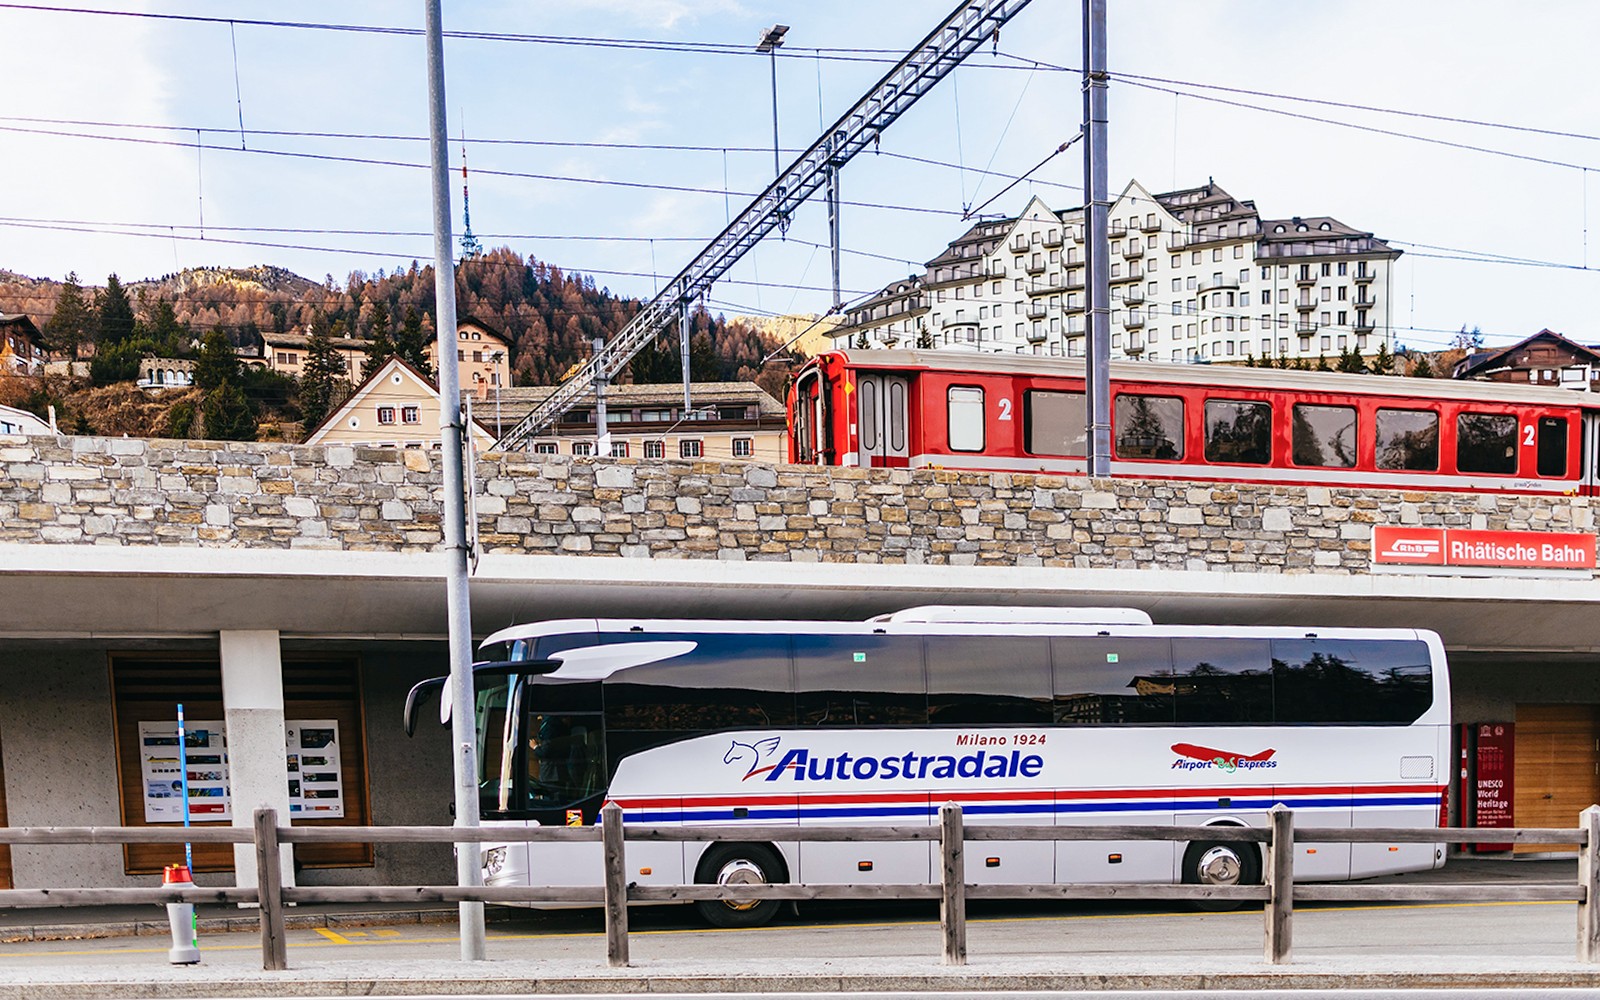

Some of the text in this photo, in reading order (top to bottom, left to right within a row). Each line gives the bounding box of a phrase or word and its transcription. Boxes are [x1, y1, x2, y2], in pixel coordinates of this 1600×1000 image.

[998, 398, 1012, 421] 2
[1523, 424, 1535, 446] 2
[1400, 544, 1423, 552] RhB
[1451, 541, 1585, 562] Rhätische Bahn
[956, 734, 1047, 746] Milano 1924
[764, 749, 1044, 782] Autostradale
[1171, 759, 1212, 771] Airport
[1237, 759, 1277, 770] Express
[1477, 780, 1503, 788] UNESCO
[1477, 799, 1508, 809] Heritage
